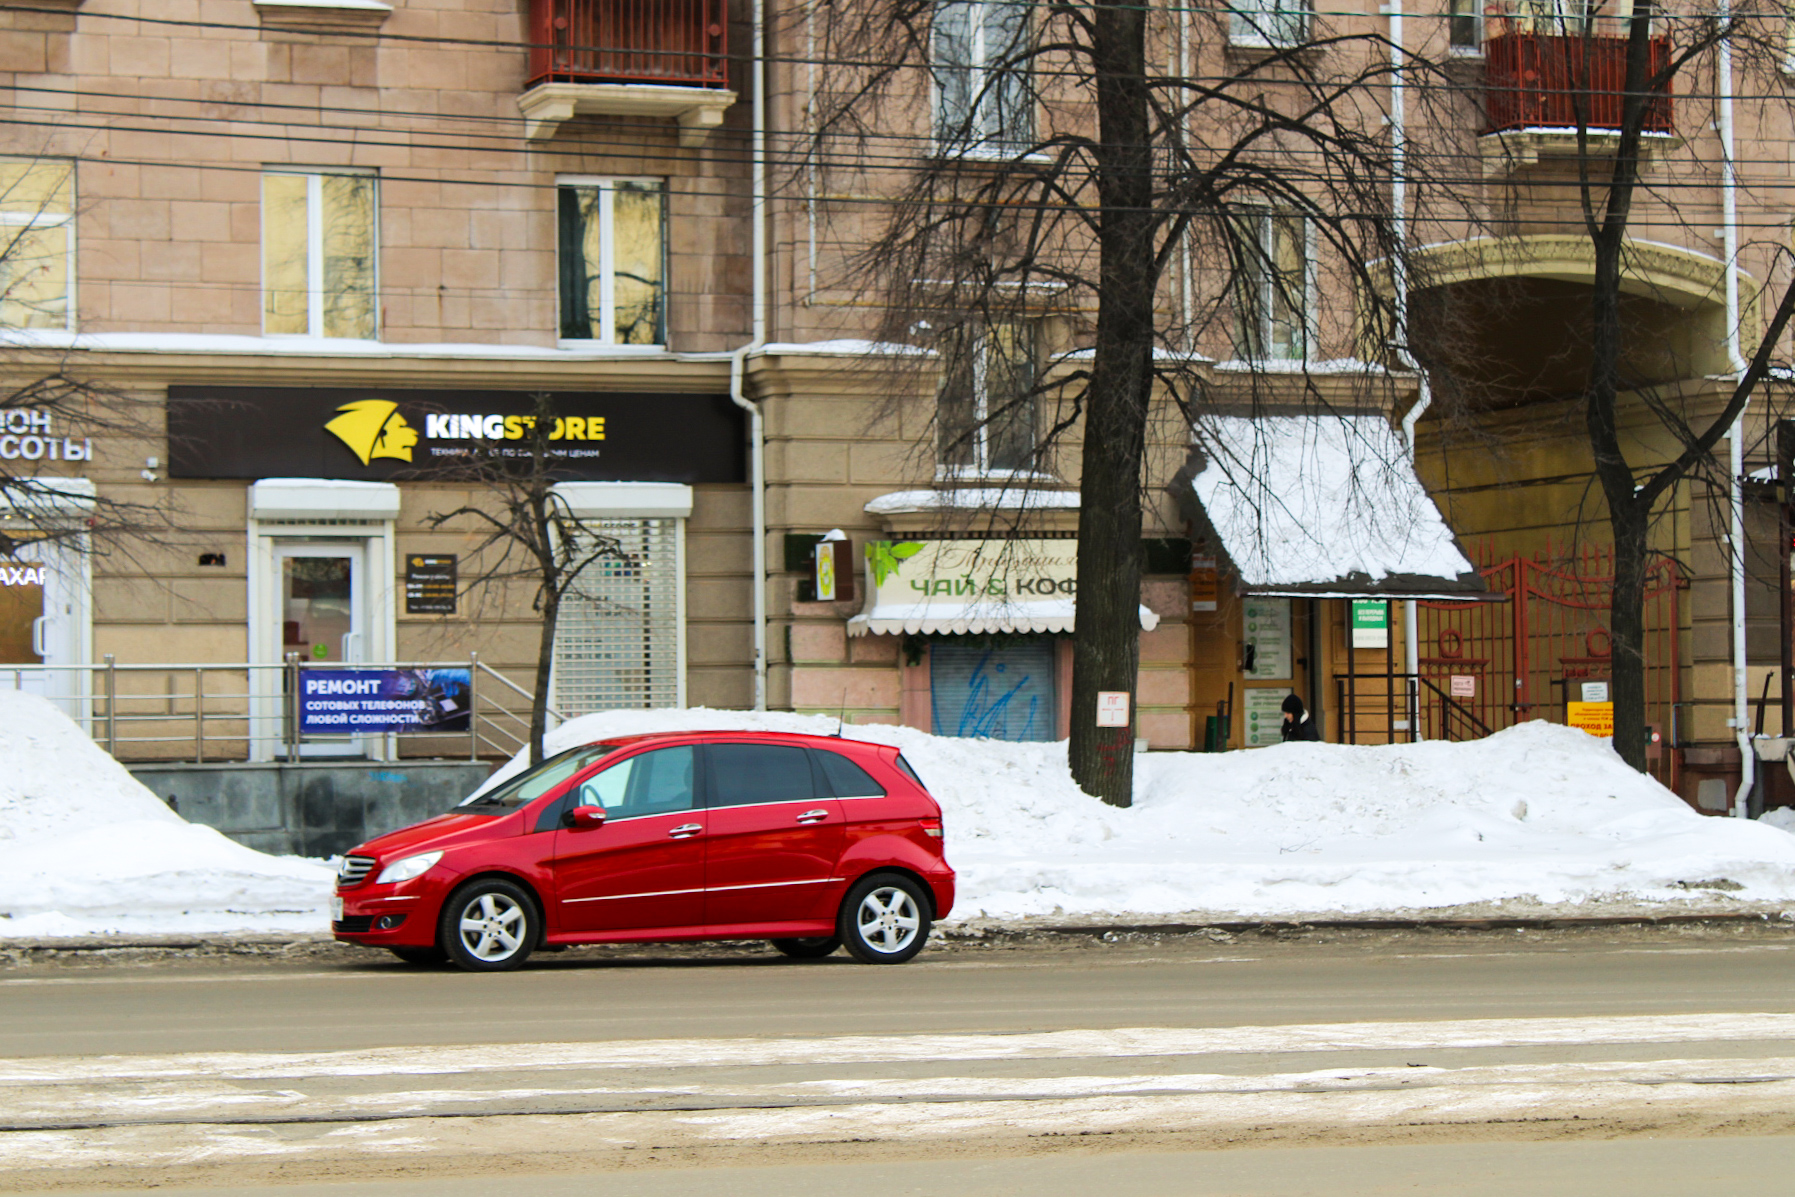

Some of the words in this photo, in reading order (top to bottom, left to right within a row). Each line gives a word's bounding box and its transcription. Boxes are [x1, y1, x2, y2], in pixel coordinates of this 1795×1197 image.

[910, 573, 975, 597] ЧАЙ
[986, 578, 1006, 597] &
[306, 679, 381, 695] РЕМОНТ
[305, 700, 360, 711] СОТОВЫХ
[361, 699, 426, 711] ТЕЛЕФОНОВ
[305, 712, 348, 725] ЛЮБОЙ
[349, 713, 420, 724] СЛОЖНОСТИ
